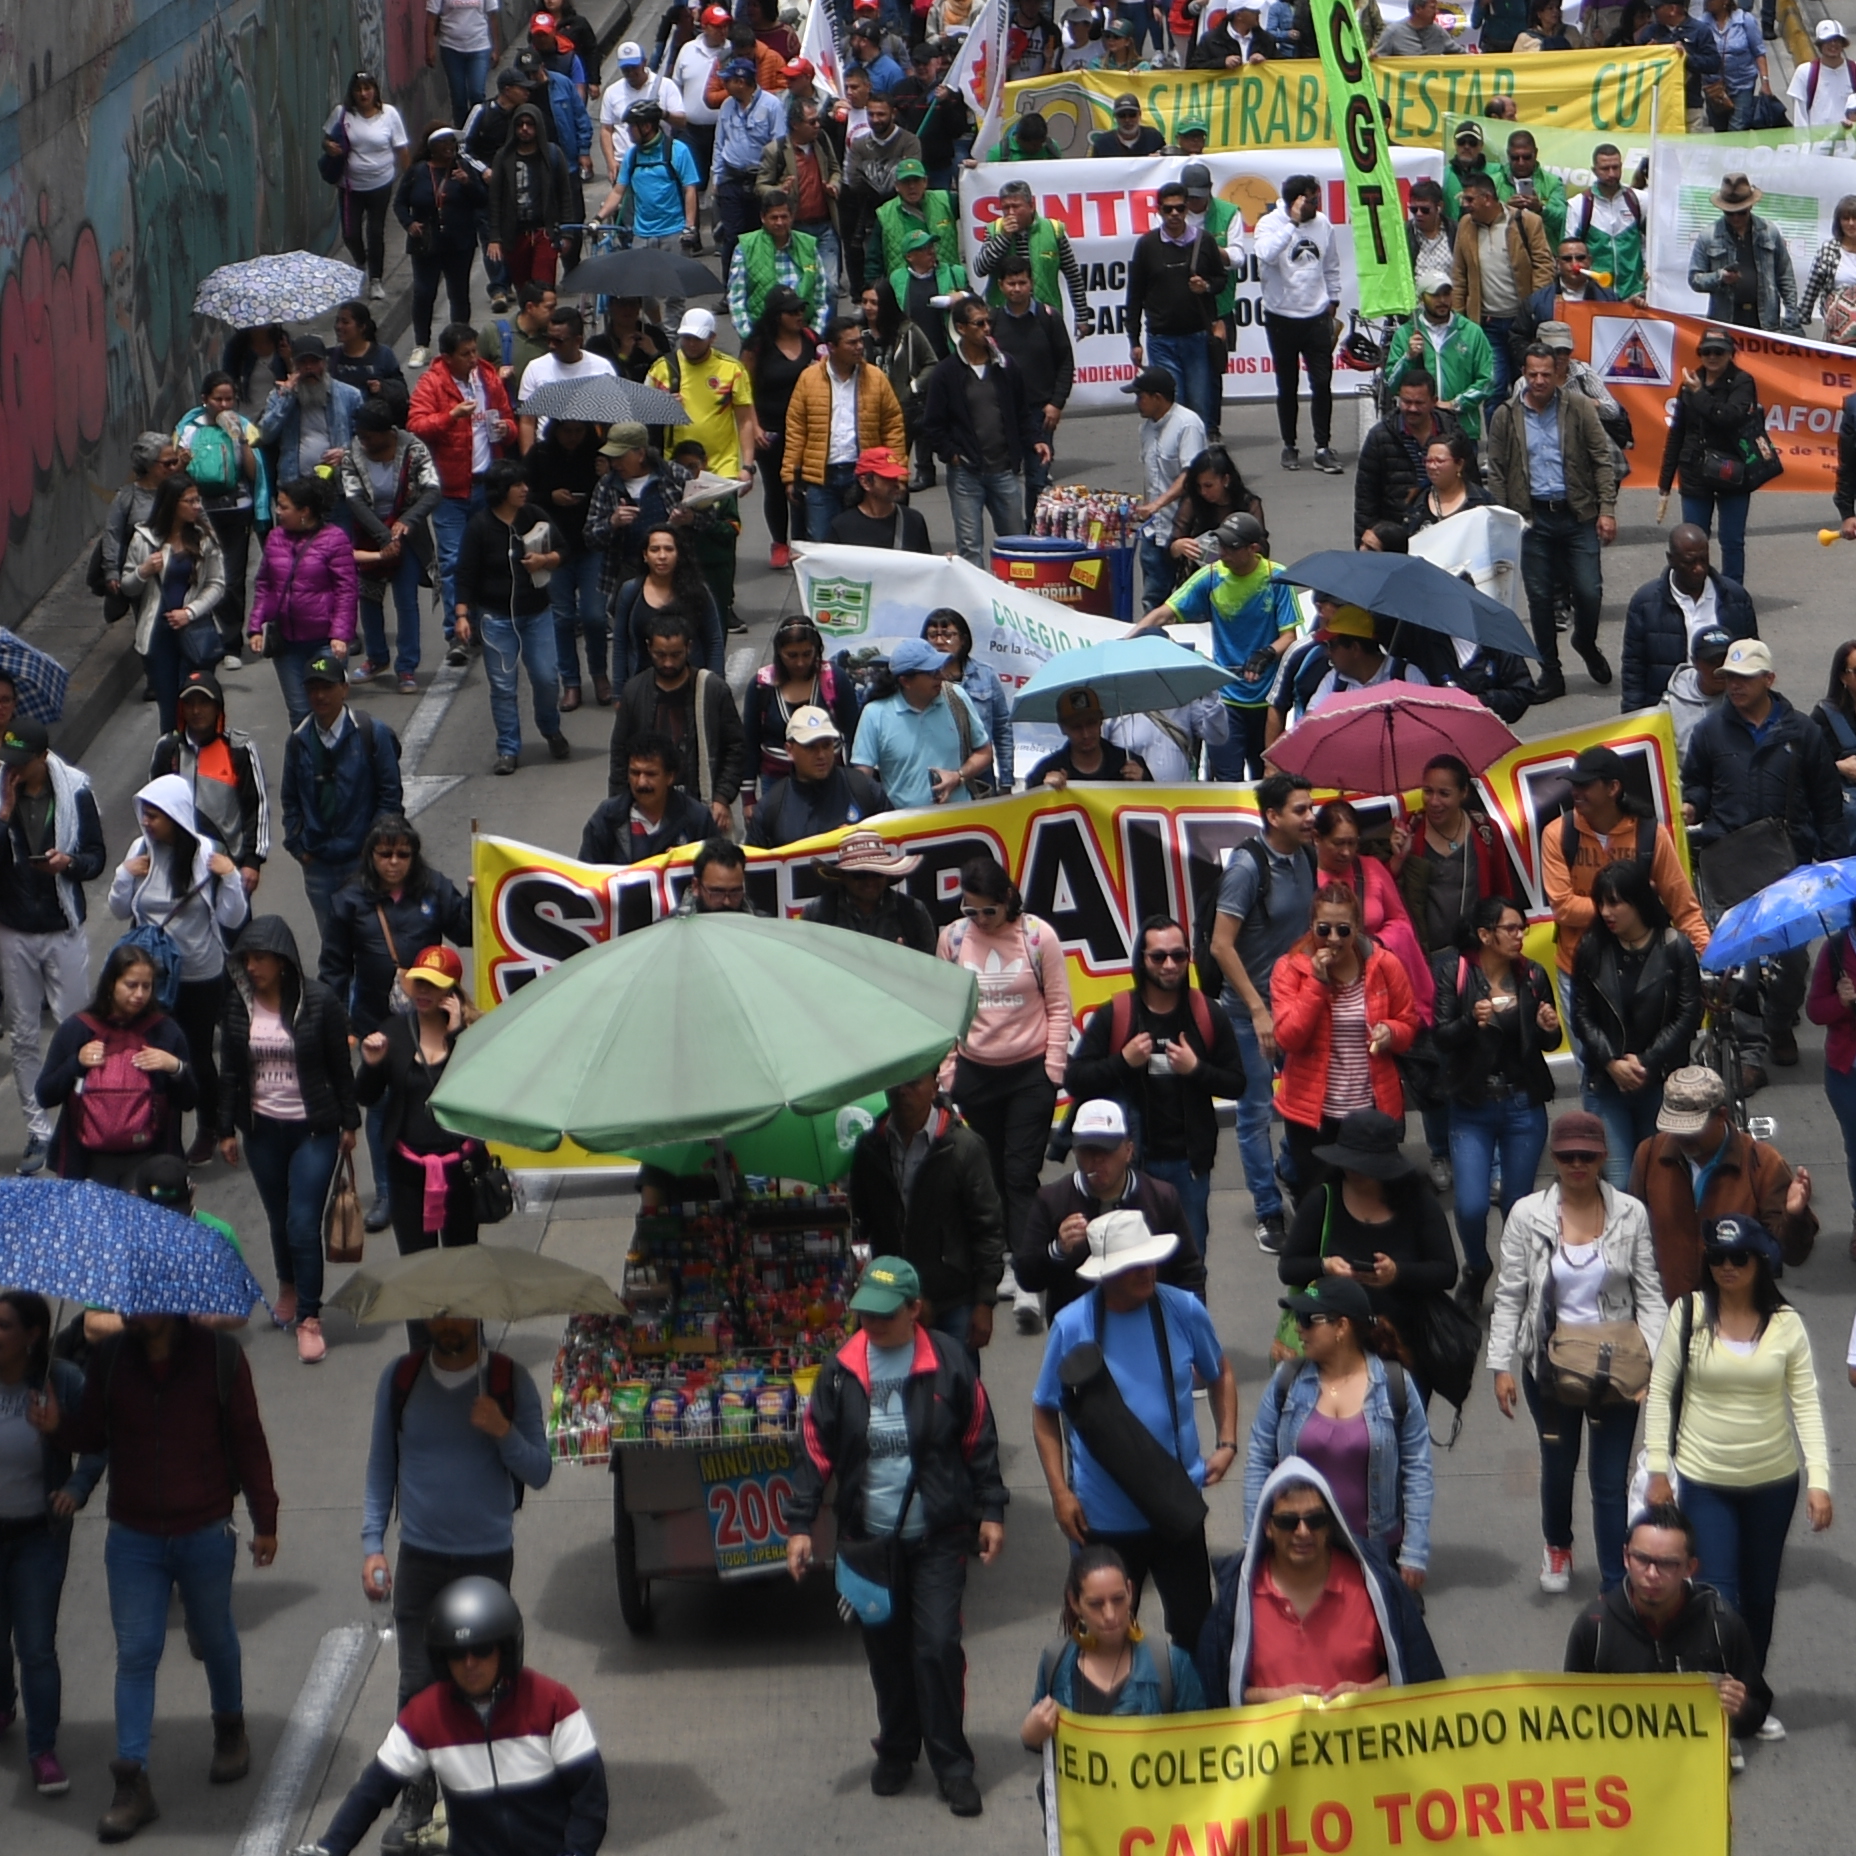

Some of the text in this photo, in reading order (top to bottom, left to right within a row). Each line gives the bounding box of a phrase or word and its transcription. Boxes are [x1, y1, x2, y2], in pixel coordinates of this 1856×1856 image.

[1592, 59, 1671, 130] CUT
[1329, 0, 1388, 264] CGT
[1821, 372, 1851, 388] DE
[1011, 566, 1033, 577] NUEVO
[1072, 565, 1096, 585] NUEVO
[989, 640, 1006, 653] Por
[1011, 641, 1023, 654] la
[991, 598, 1073, 651] COLEGIO
[699, 1444, 790, 1481] MINUTOS
[707, 1477, 794, 1548] 200
[718, 1547, 748, 1567] TODO
[1130, 1741, 1279, 1788] COLEGIO
[1290, 1709, 1508, 1769] EXTERNADO
[1519, 1702, 1709, 1743] NACIONAL
[1117, 1773, 1633, 1856] CAMILO TORRES
